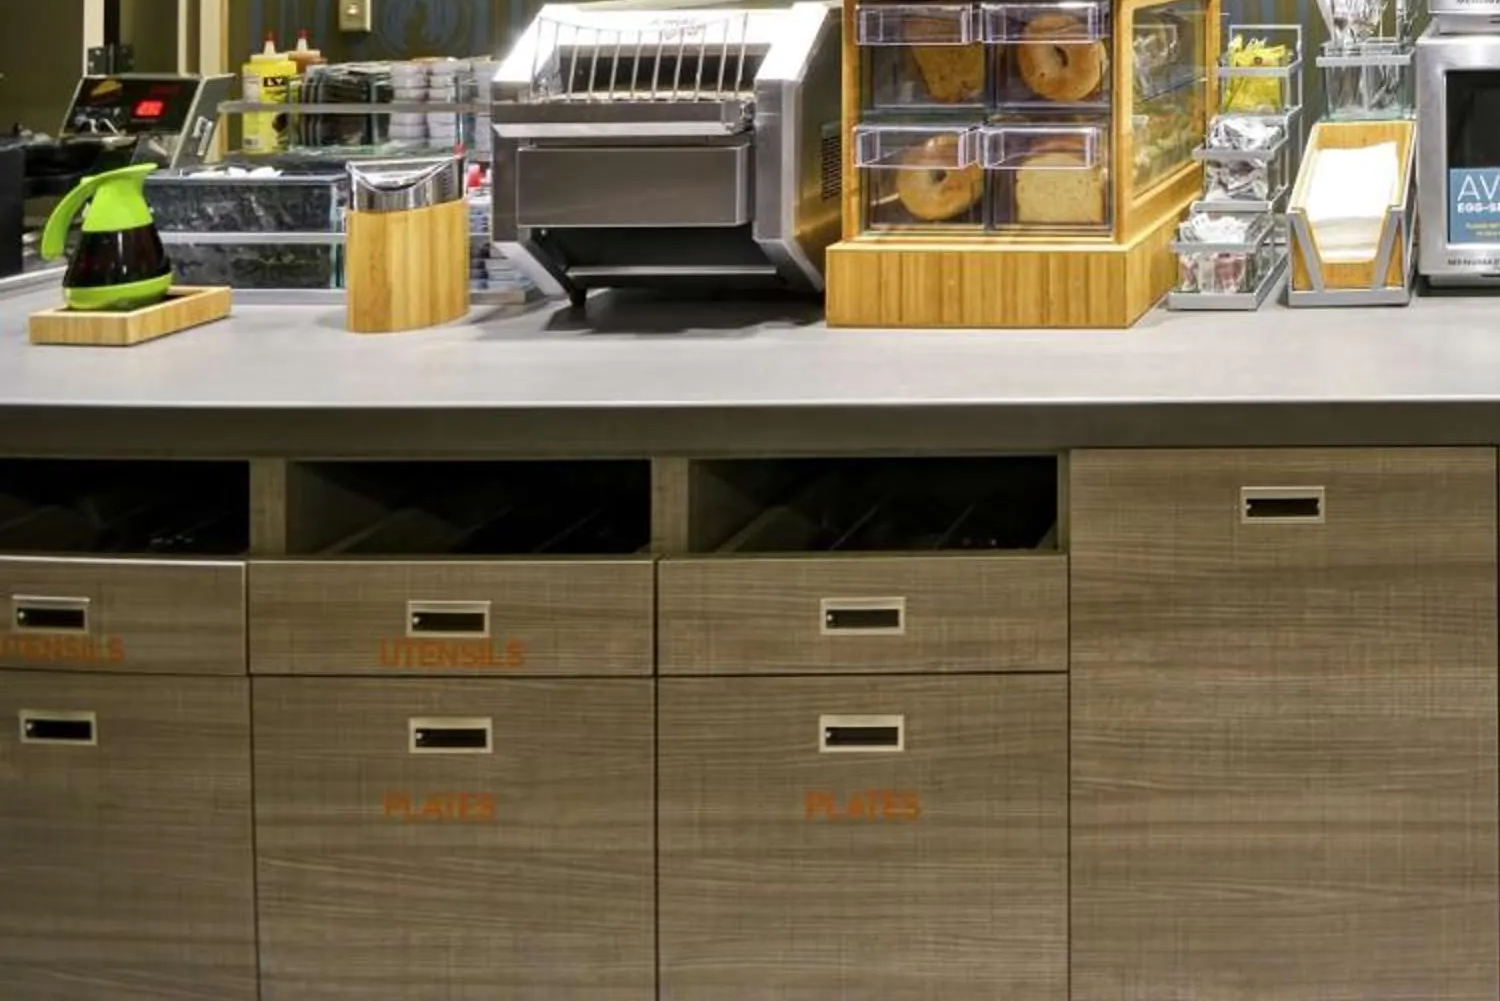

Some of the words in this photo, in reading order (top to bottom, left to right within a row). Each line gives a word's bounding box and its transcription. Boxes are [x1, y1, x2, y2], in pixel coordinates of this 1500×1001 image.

[379, 635, 526, 668] UTENSILS
[383, 790, 497, 824] PLATES
[803, 789, 924, 824] PLATES
